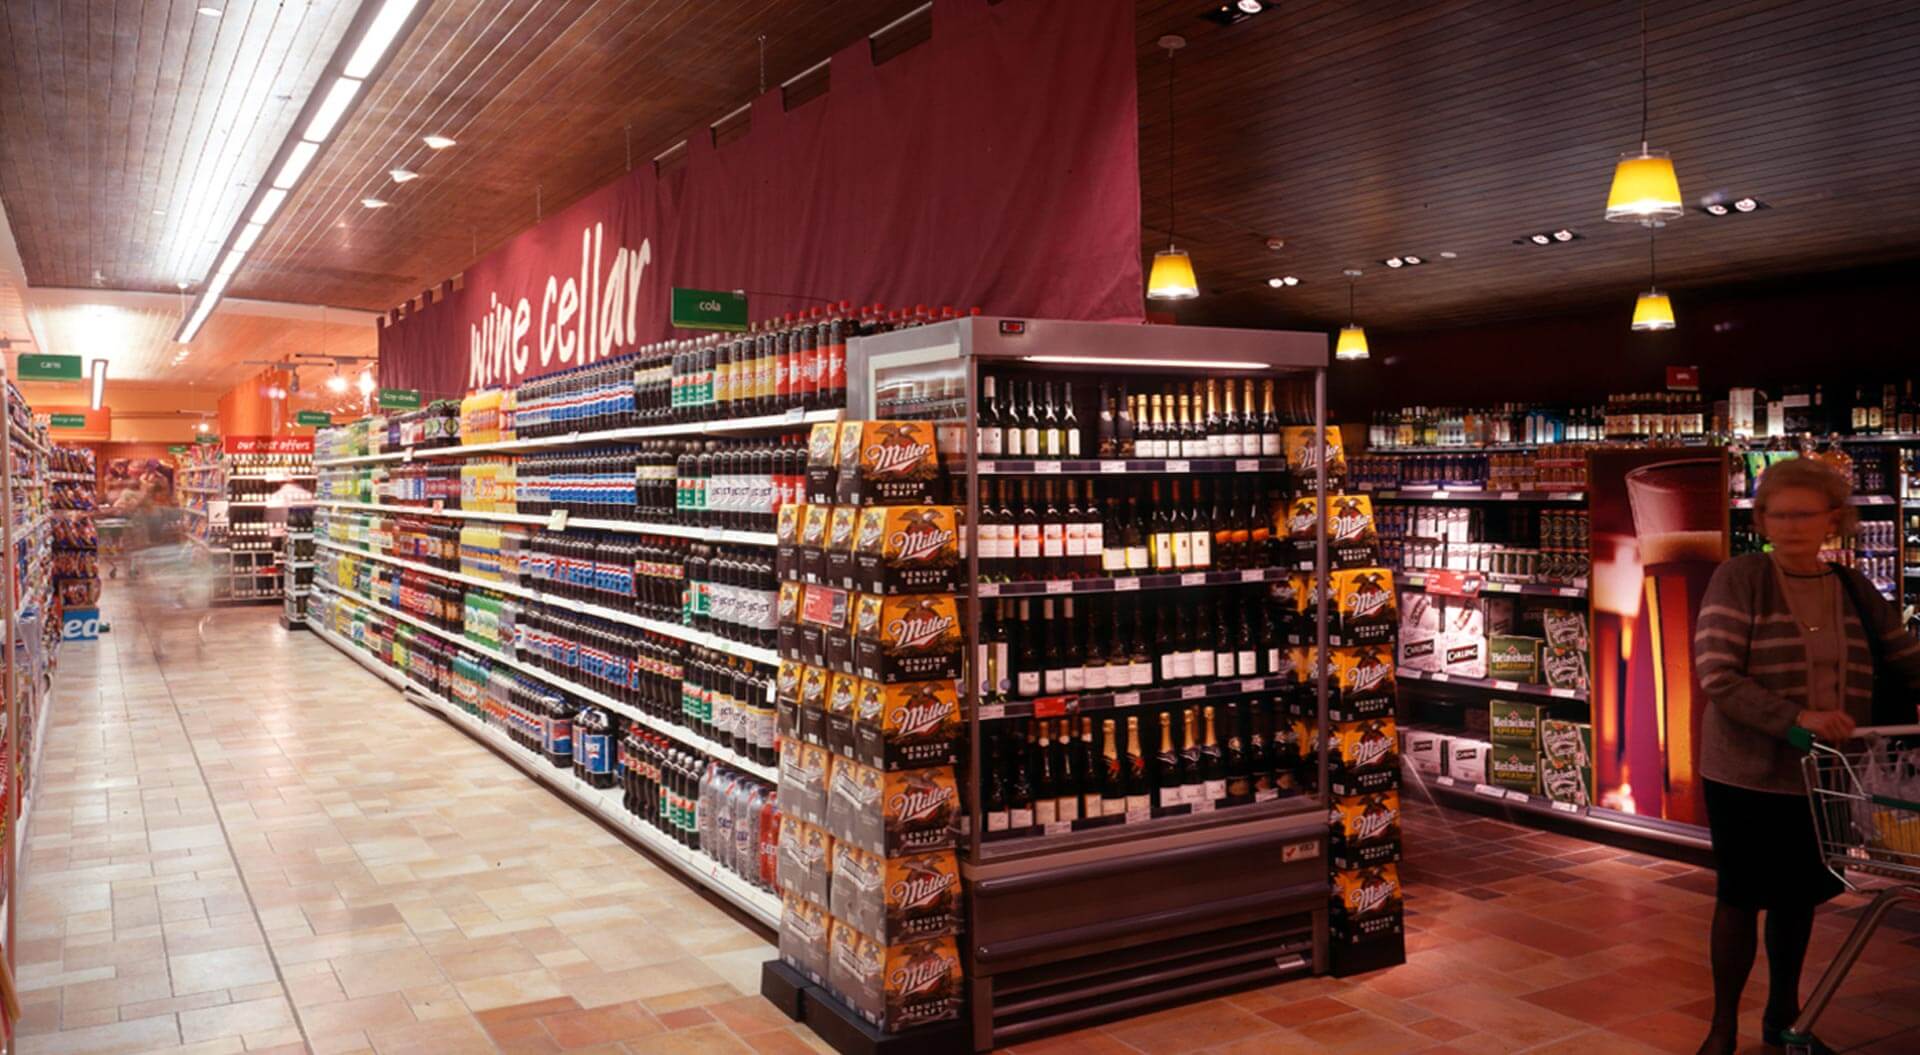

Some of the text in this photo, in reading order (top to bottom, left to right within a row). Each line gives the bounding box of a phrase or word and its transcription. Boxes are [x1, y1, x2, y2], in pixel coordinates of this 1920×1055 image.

[469, 222, 651, 388] wine cellar
[699, 300, 721, 312] cola
[237, 441, 255, 450] our
[280, 439, 311, 452] offers
[865, 442, 932, 471] Miller
[877, 482, 925, 491] GENUINE
[883, 488, 918, 497] DRAFT
[1328, 513, 1371, 541] Miller
[890, 528, 953, 559] Miller
[901, 569, 948, 579] GENUINE
[906, 576, 941, 585] DRAFT
[1345, 590, 1391, 618] Miller
[887, 616, 953, 647] Miller
[897, 656, 948, 666] GENUINE
[905, 663, 941, 672] DRAFT
[890, 701, 954, 733] Miller
[901, 742, 949, 752] GENUINE
[907, 750, 942, 760] DRAFT
[890, 786, 953, 820] Miller
[890, 873, 953, 907] Miller
[890, 958, 953, 994] Miller
